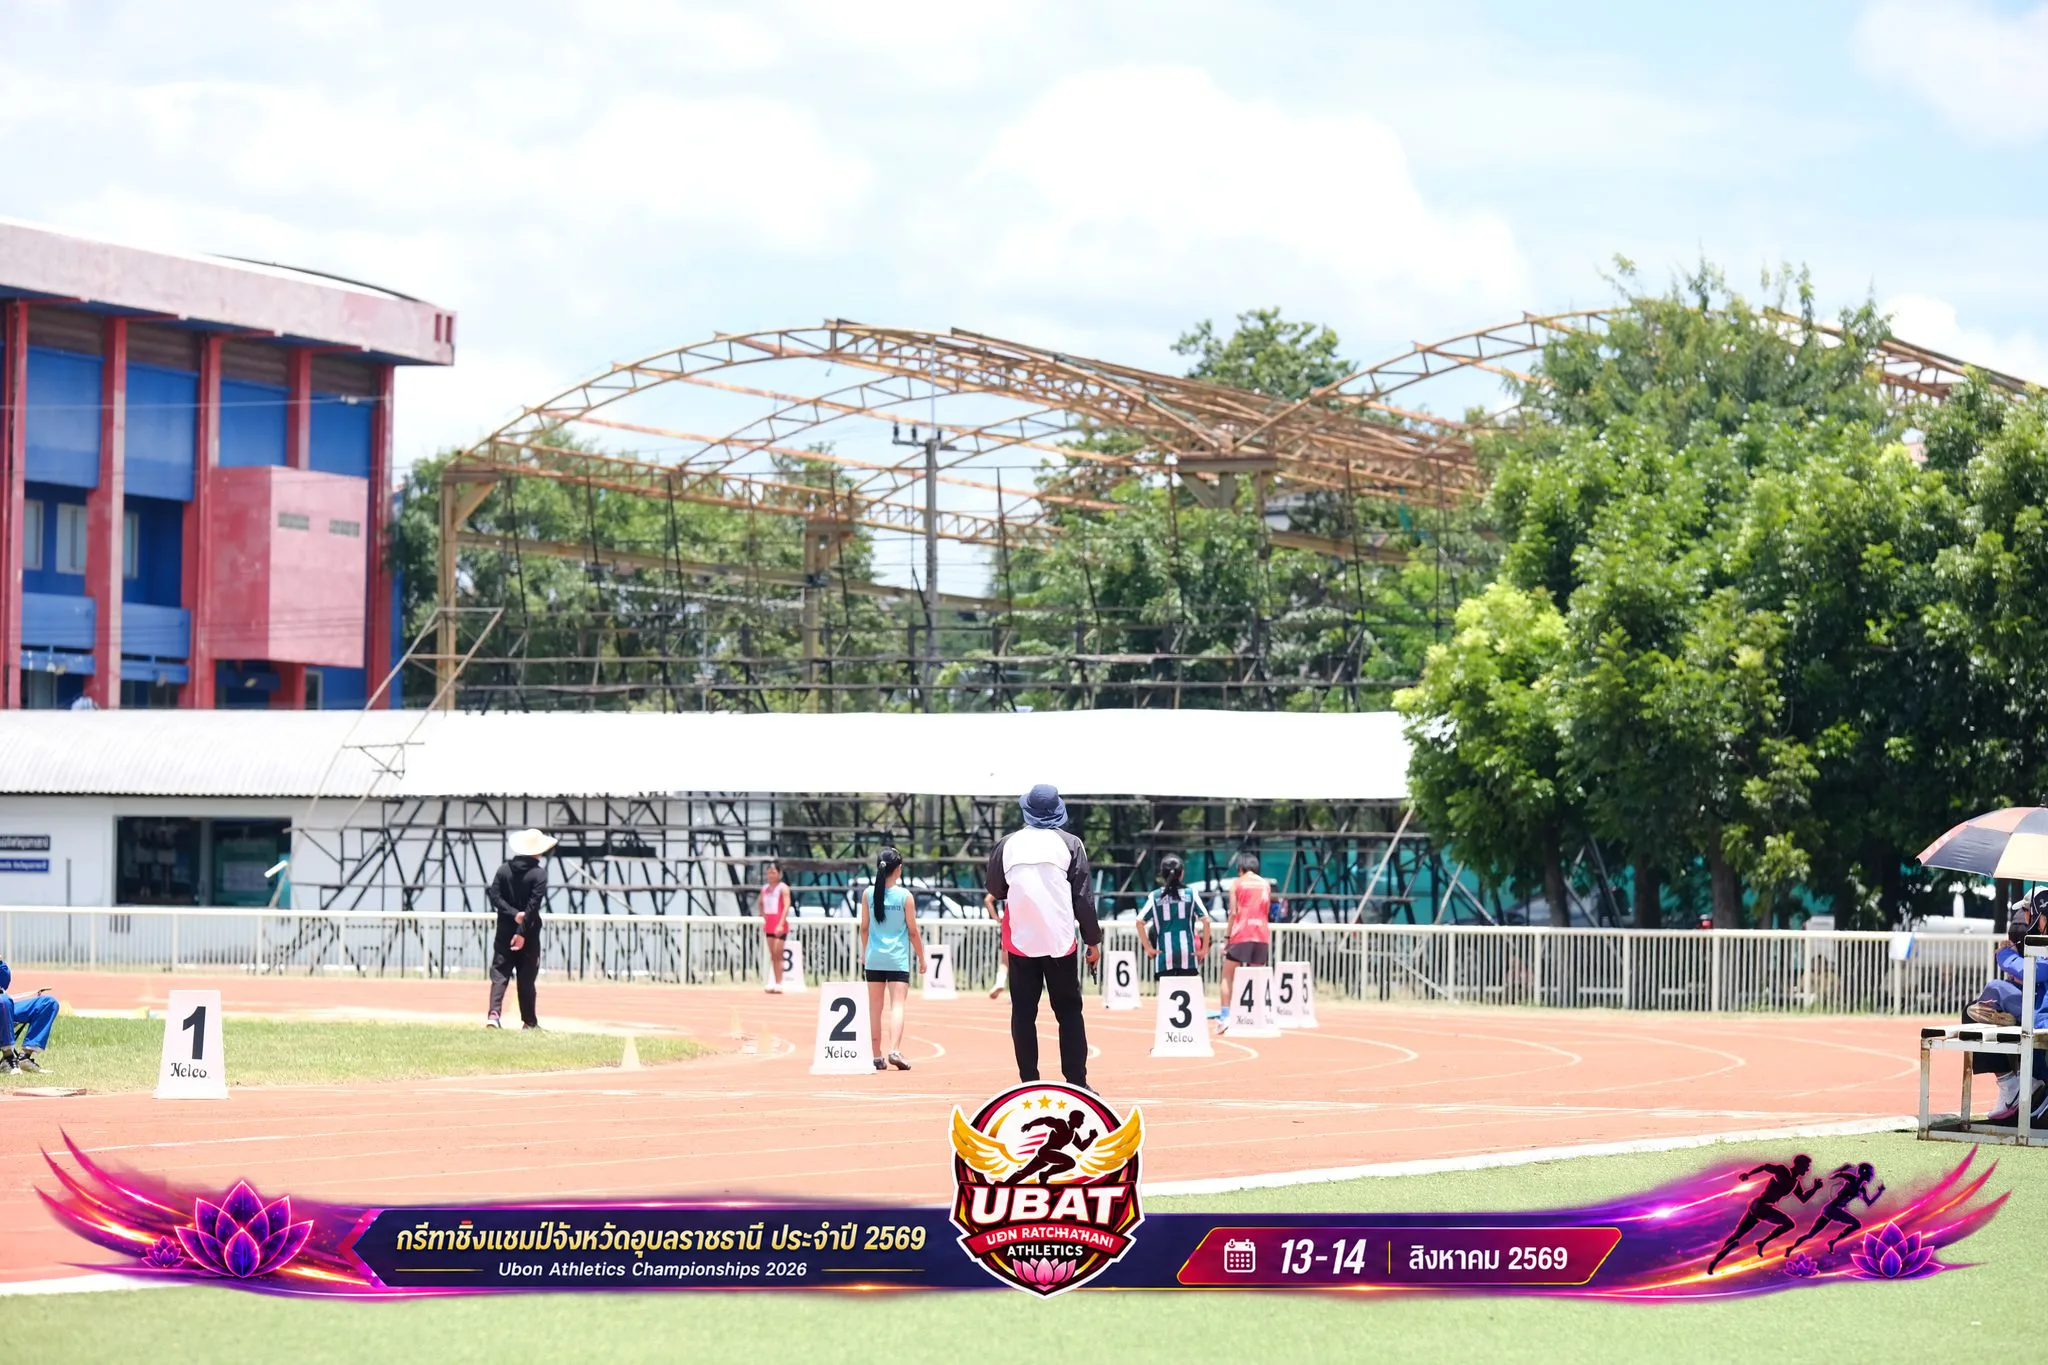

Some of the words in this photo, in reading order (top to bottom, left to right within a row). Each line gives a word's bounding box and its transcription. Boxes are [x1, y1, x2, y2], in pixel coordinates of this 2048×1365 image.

[930, 953, 944, 979] 7
[1115, 960, 1130, 987] 6
[1239, 979, 1255, 1013] 4
[1264, 978, 1272, 1013] 4
[1279, 972, 1294, 1004] 5
[1302, 972, 1309, 1004] 5
[829, 997, 857, 1041] 2
[1169, 990, 1193, 1029] 3
[182, 1006, 207, 1060] 1
[1166, 1031, 1194, 1043] Nelco
[824, 1045, 858, 1059] Nelco
[170, 1062, 208, 1079] Nelco
